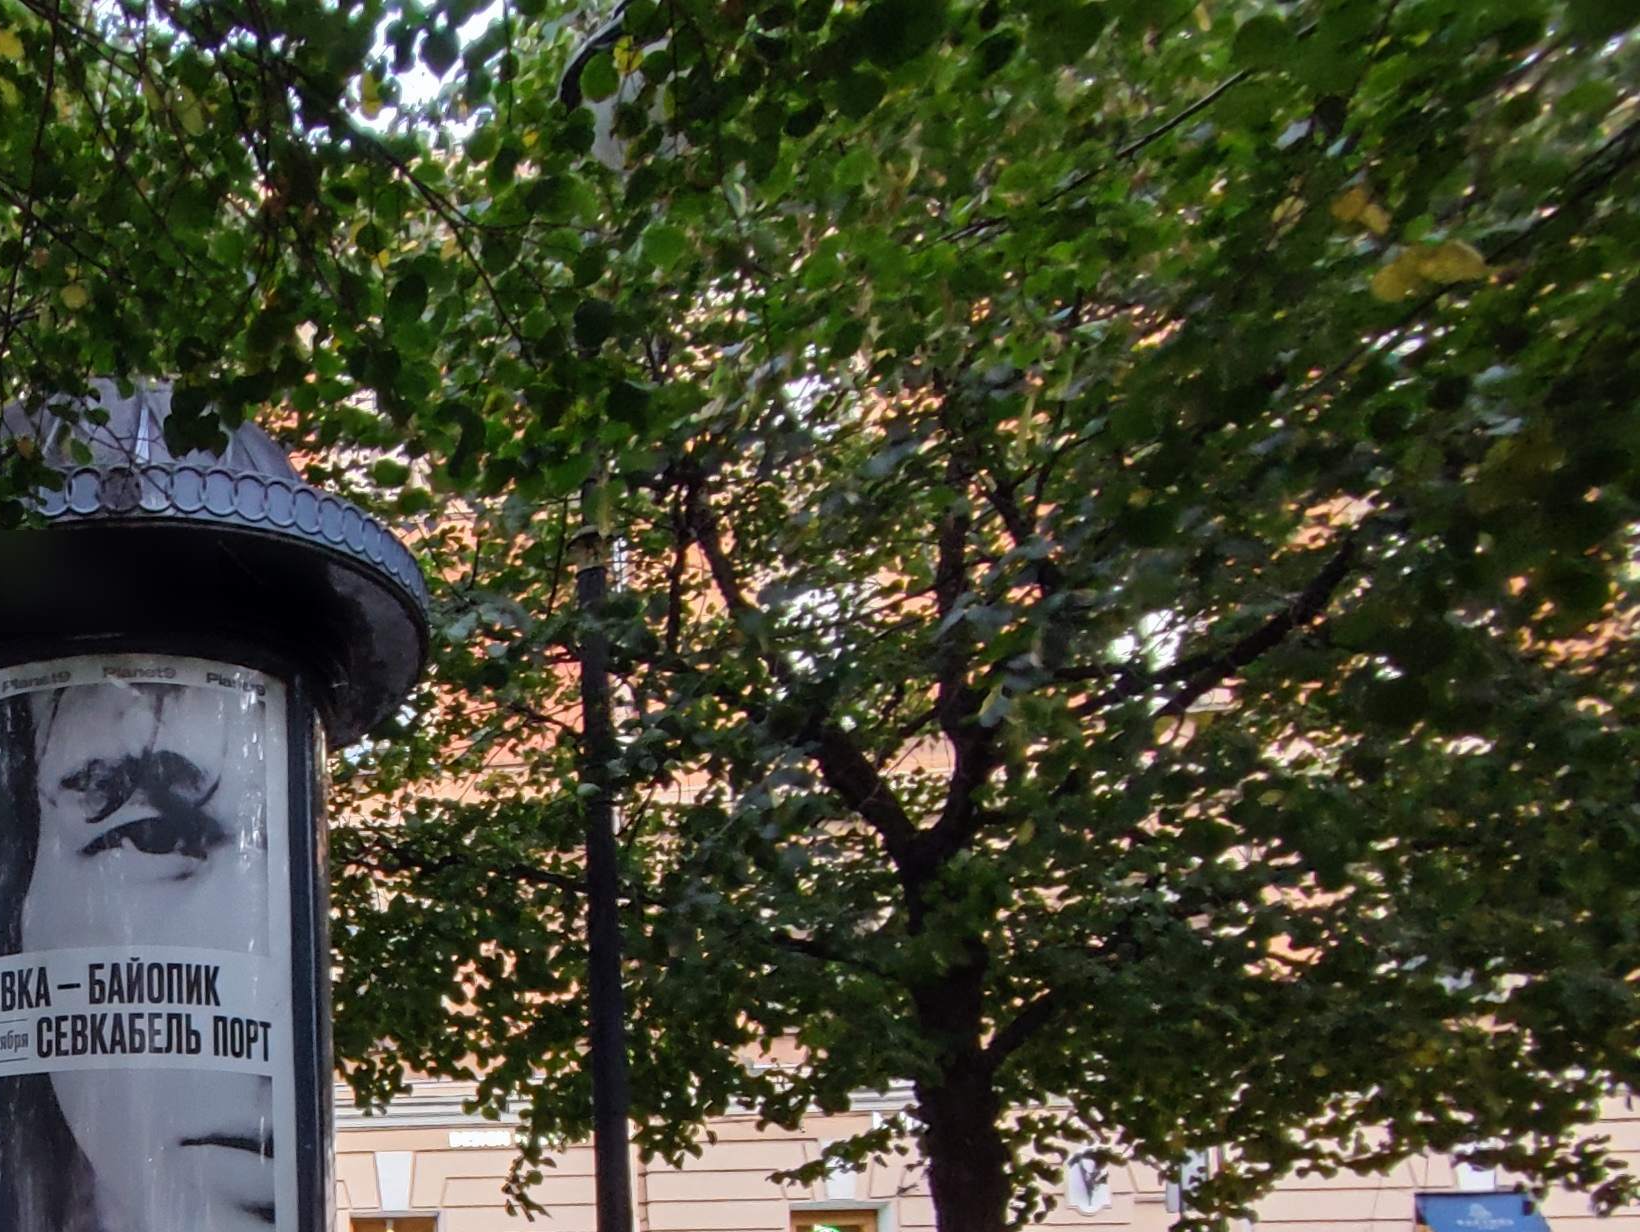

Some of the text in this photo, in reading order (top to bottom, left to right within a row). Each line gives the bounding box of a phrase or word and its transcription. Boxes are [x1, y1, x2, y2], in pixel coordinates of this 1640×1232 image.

[103, 666, 177, 679] Planet9
[88, 957, 220, 1007] БАЙОПИК
[36, 1012, 272, 1062] СЕВКАБЕЛЬ ПОРТ
